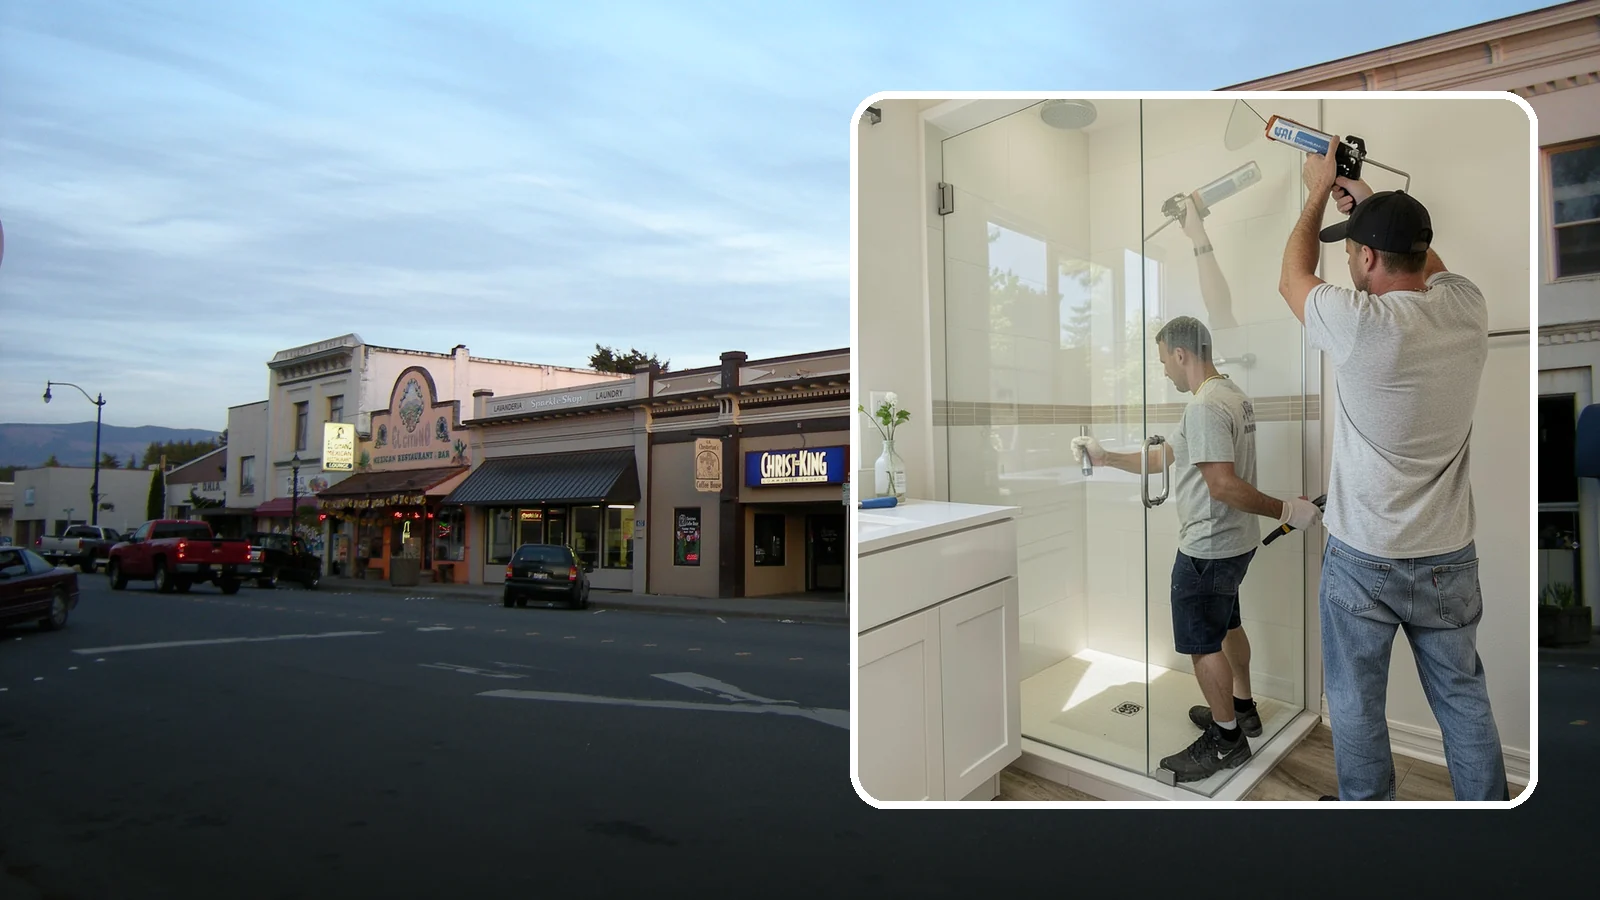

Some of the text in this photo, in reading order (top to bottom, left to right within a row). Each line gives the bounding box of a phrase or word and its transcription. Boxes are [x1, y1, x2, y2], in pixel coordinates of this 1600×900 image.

[595, 388, 624, 400] LAUNDRY
[493, 402, 523, 413] LAVANDERIA
[530, 394, 583, 409] Sparkle Shop
[373, 450, 450, 464] MEXICAN RESTAURANT BAR
[799, 450, 827, 476] KING
